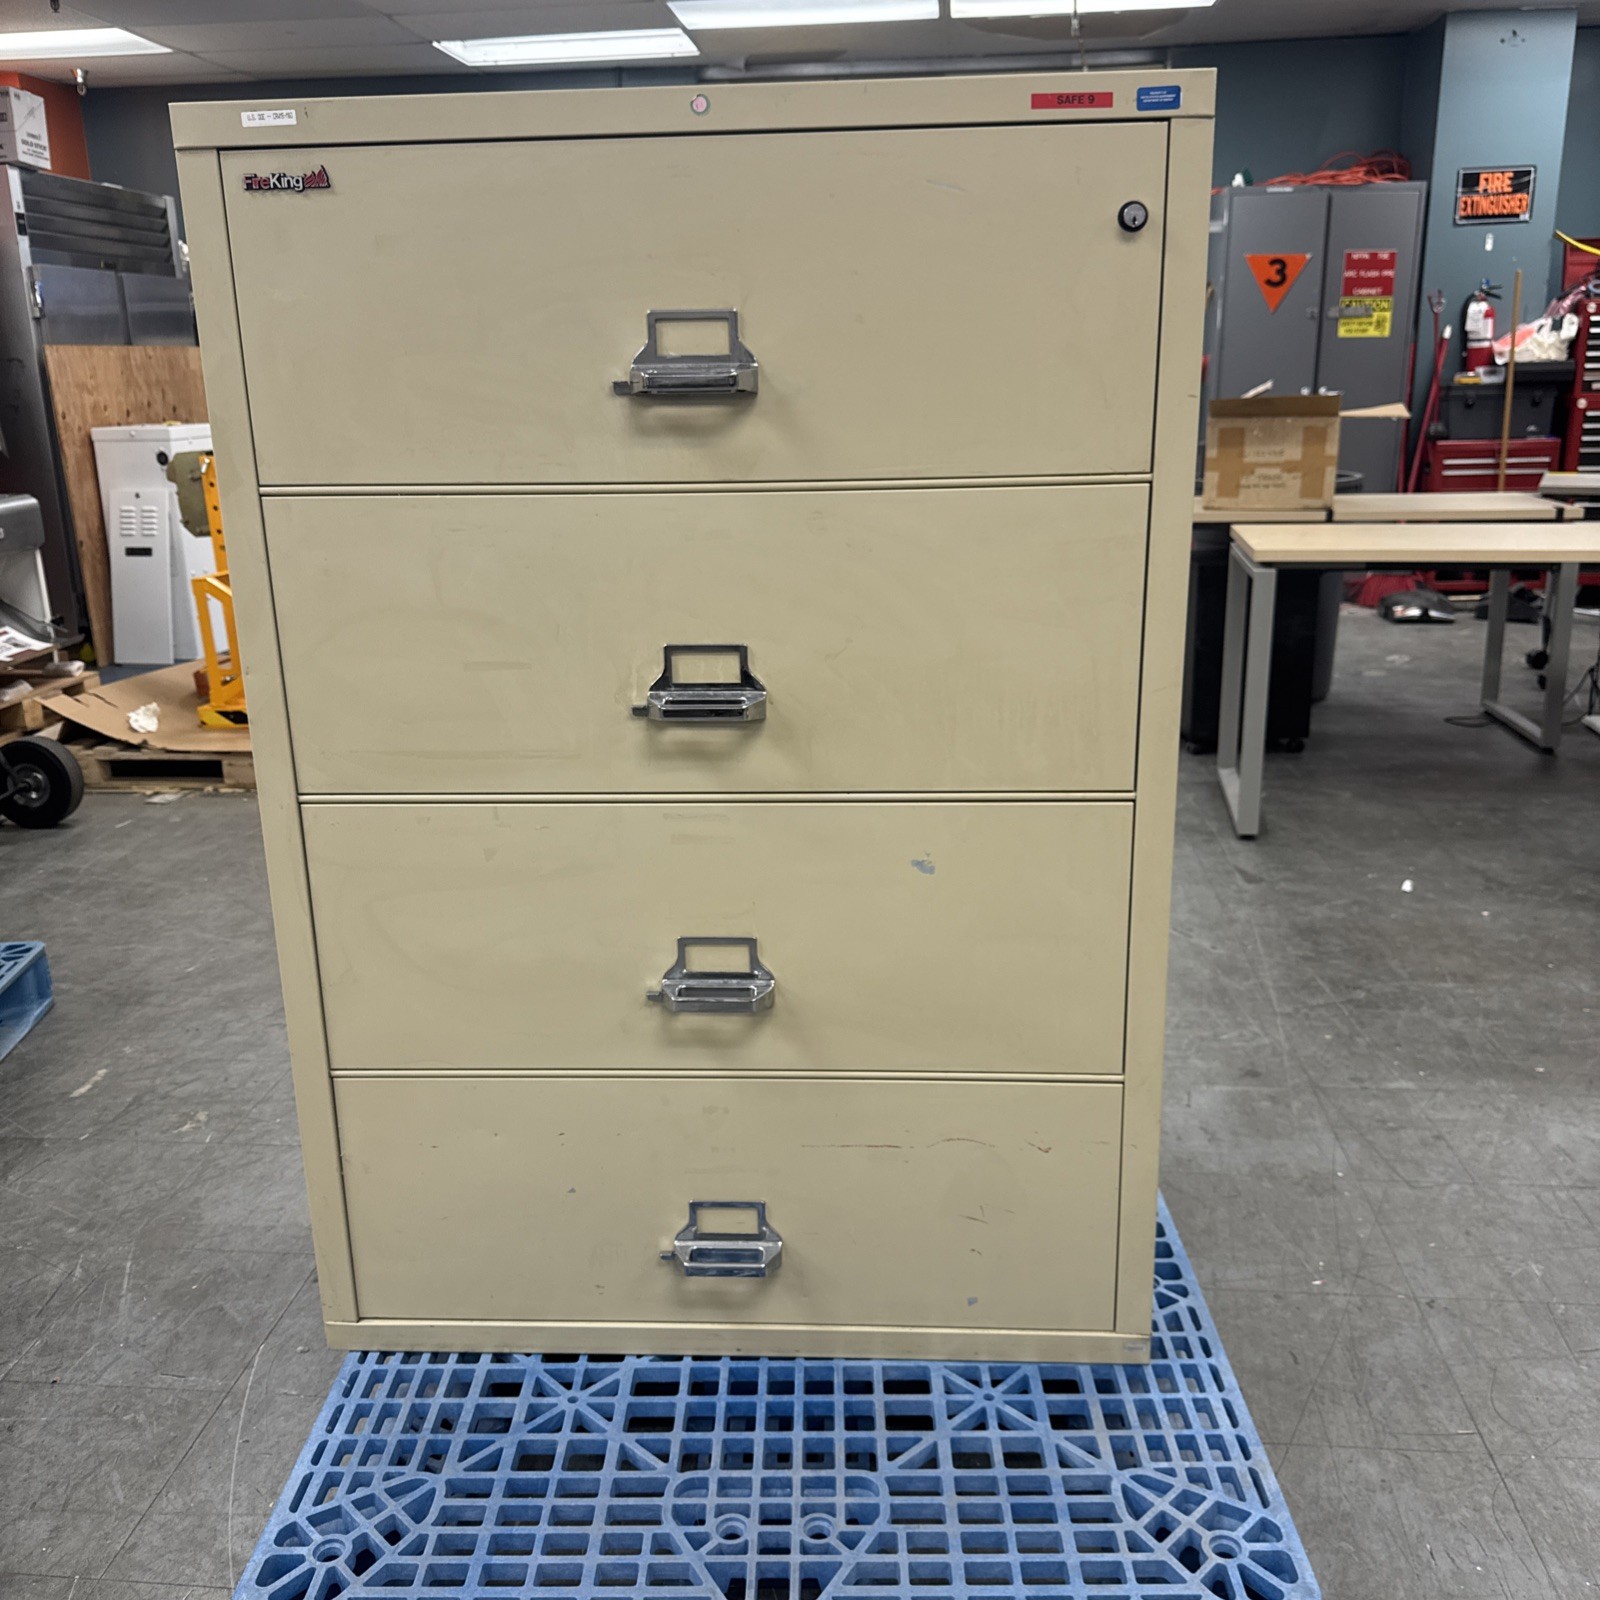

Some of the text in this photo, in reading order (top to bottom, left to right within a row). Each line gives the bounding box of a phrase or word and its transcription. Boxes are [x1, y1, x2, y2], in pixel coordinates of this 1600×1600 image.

[1056, 95, 1095, 105] SAFE 9
[243, 172, 304, 192] FireKing
[1479, 171, 1514, 193] FIRE
[1458, 193, 1529, 216] EXTINGUISHER
[1264, 257, 1287, 288] 3
